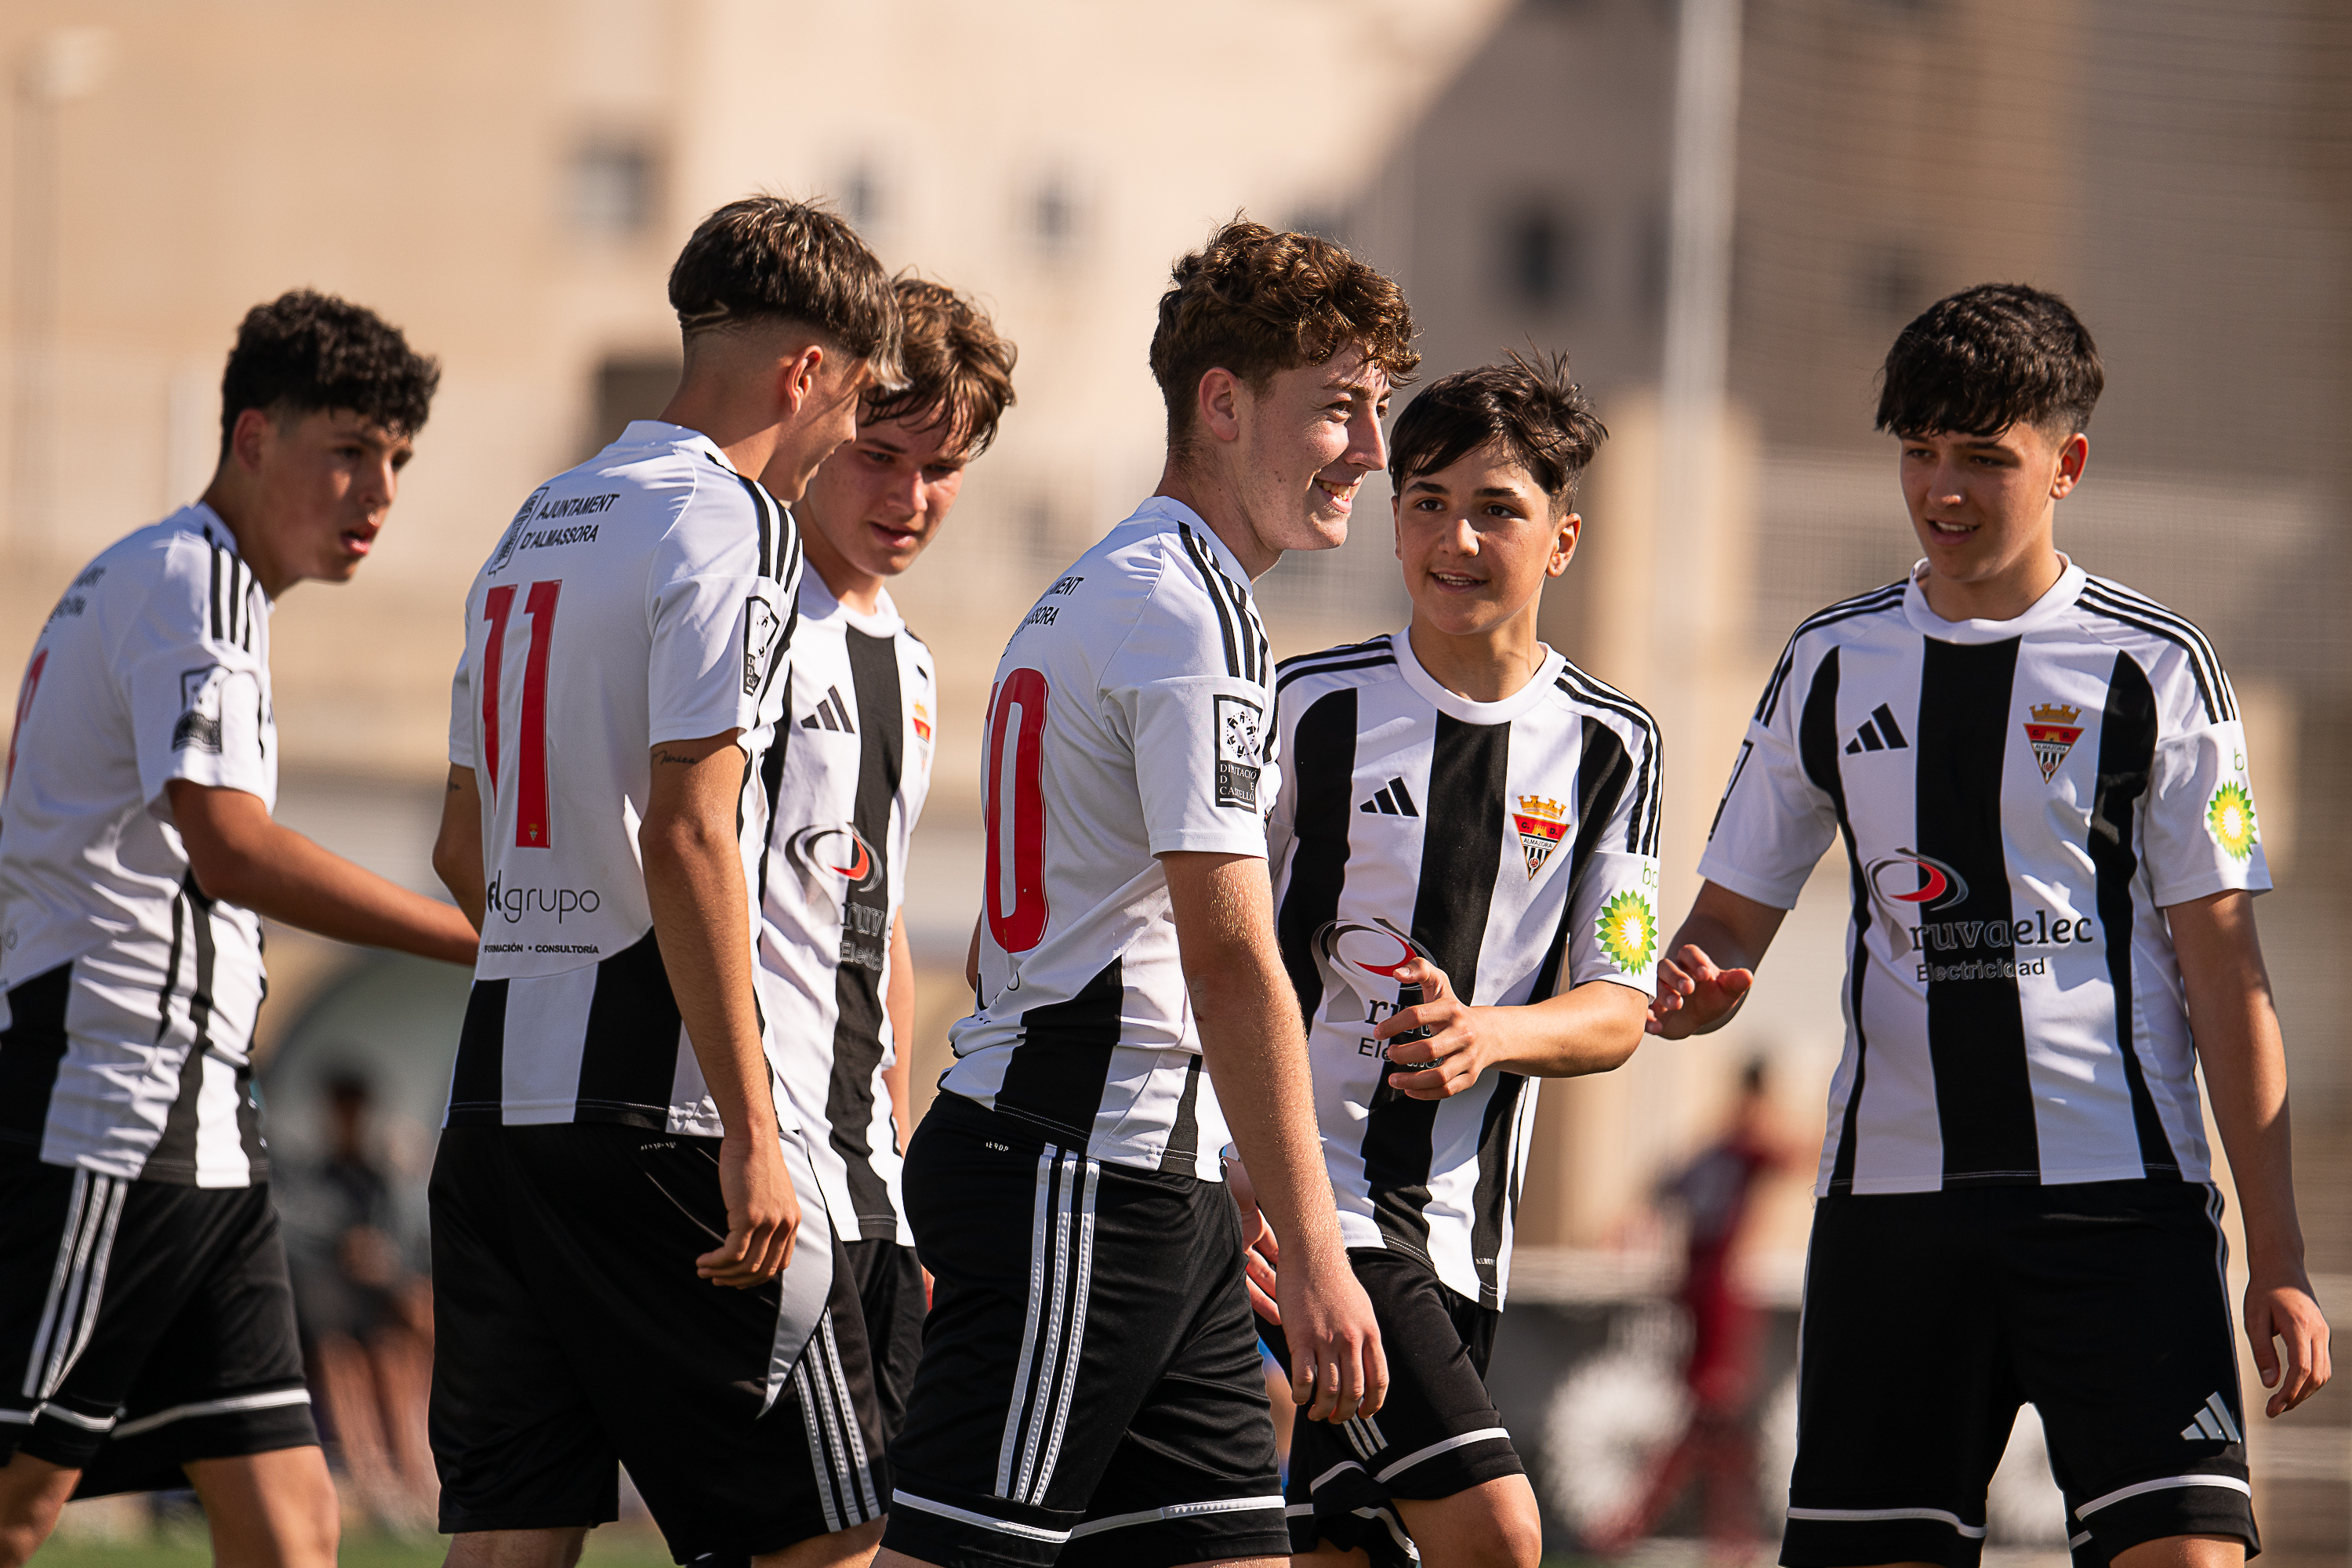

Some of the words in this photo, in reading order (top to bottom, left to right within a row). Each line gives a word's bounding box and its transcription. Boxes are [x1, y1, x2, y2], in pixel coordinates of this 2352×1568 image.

[535, 493, 620, 521] AJUNTAMENT
[519, 524, 599, 550] D'ALMASSORA
[482, 579, 562, 848] 11
[985, 667, 1050, 954] 0
[1523, 837, 1552, 848] ALMAZORA
[1909, 909, 2093, 951] ruvaelec
[535, 943, 599, 954] CONSULTORÍA
[1916, 956, 2045, 982] Electricidad
